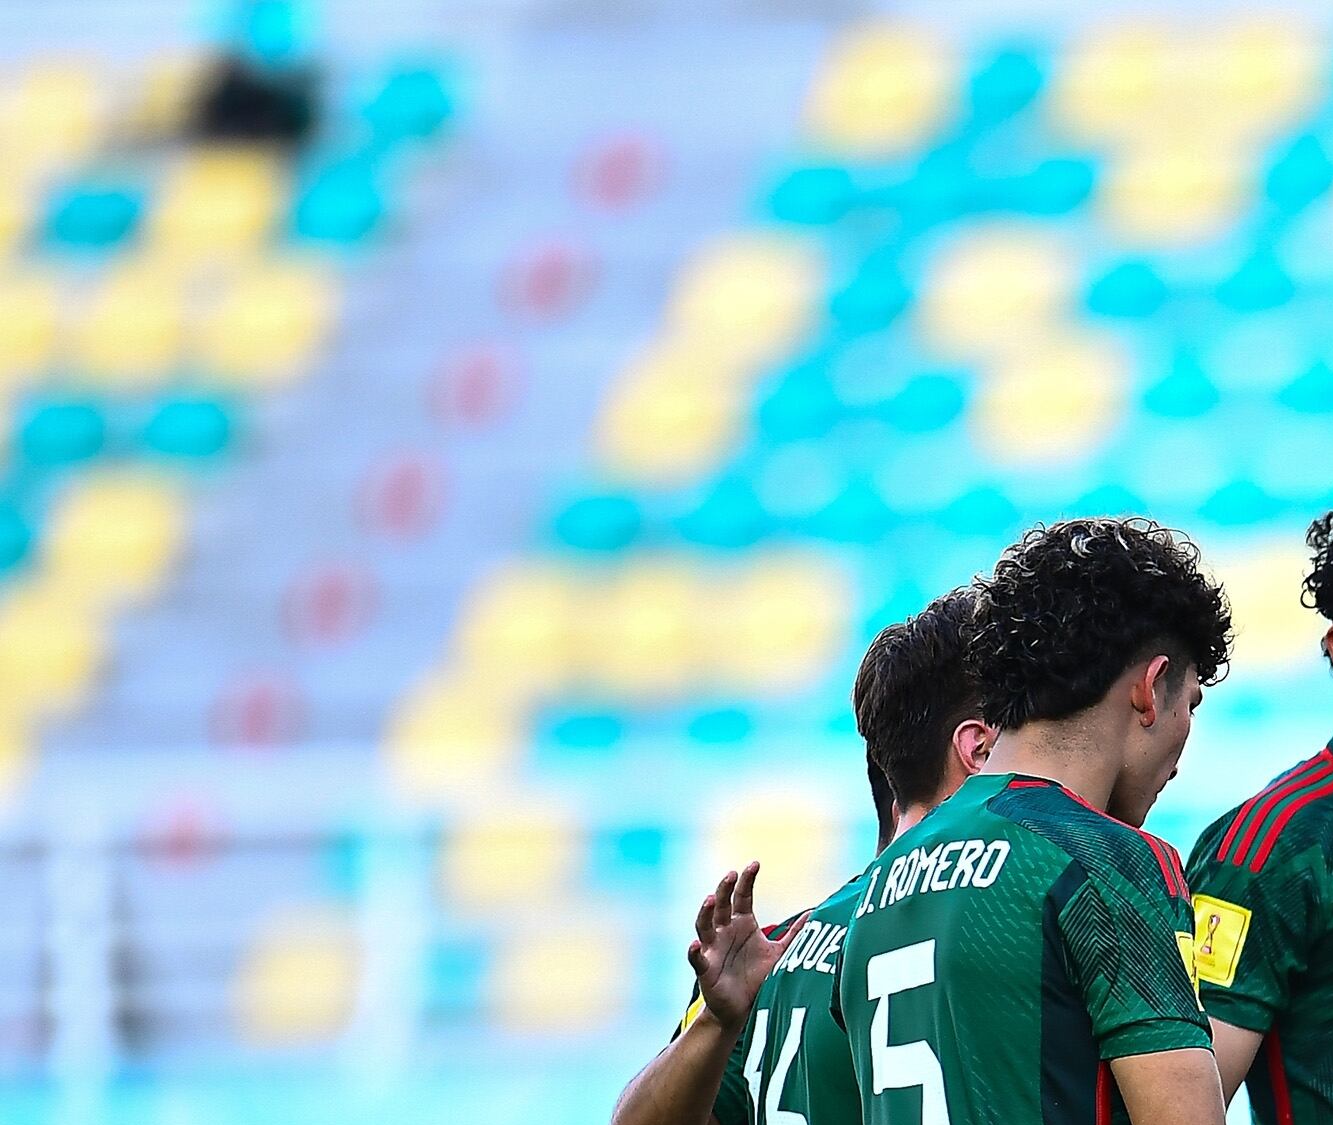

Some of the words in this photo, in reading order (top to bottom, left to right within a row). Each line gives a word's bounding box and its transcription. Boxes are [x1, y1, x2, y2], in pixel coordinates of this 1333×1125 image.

[856, 866, 881, 918] J.
[879, 839, 1011, 910] ROMERO
[773, 920, 848, 974] QUE
